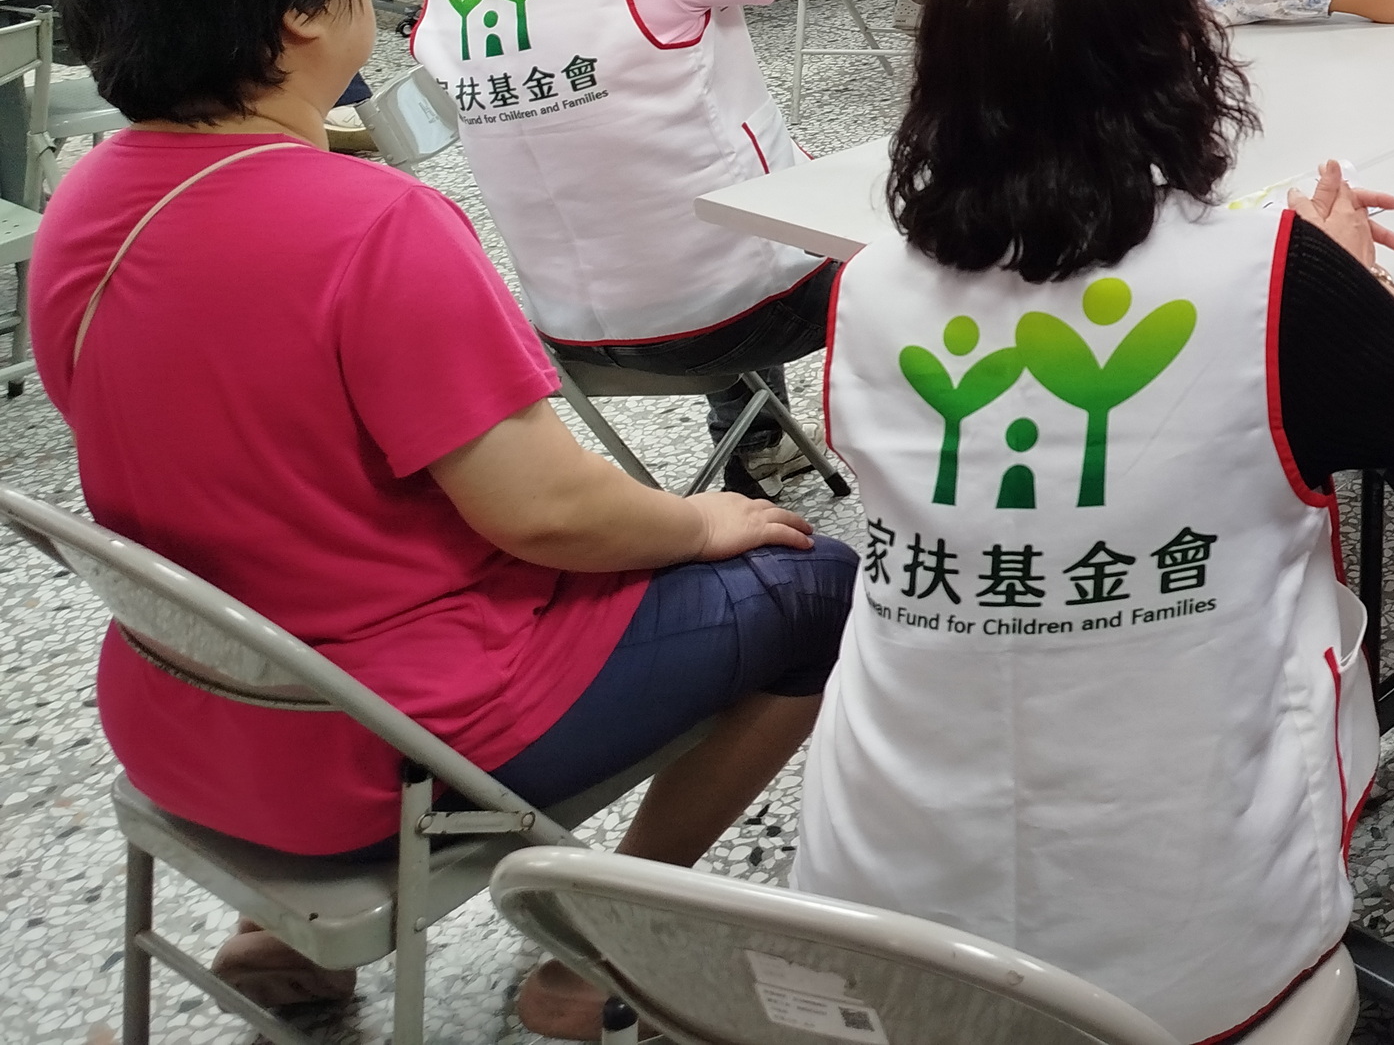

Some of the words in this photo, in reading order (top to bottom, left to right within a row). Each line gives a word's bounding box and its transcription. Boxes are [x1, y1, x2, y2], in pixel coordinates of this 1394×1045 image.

[484, 113, 497, 124] for
[499, 109, 537, 122] Children
[540, 101, 560, 115] and
[562, 89, 609, 109] Families
[864, 517, 1218, 608] 家扶基金會
[896, 606, 940, 631] Fund
[947, 614, 975, 635] for
[983, 614, 1073, 636] Children
[1081, 611, 1122, 632] and
[1130, 594, 1218, 626] Families
